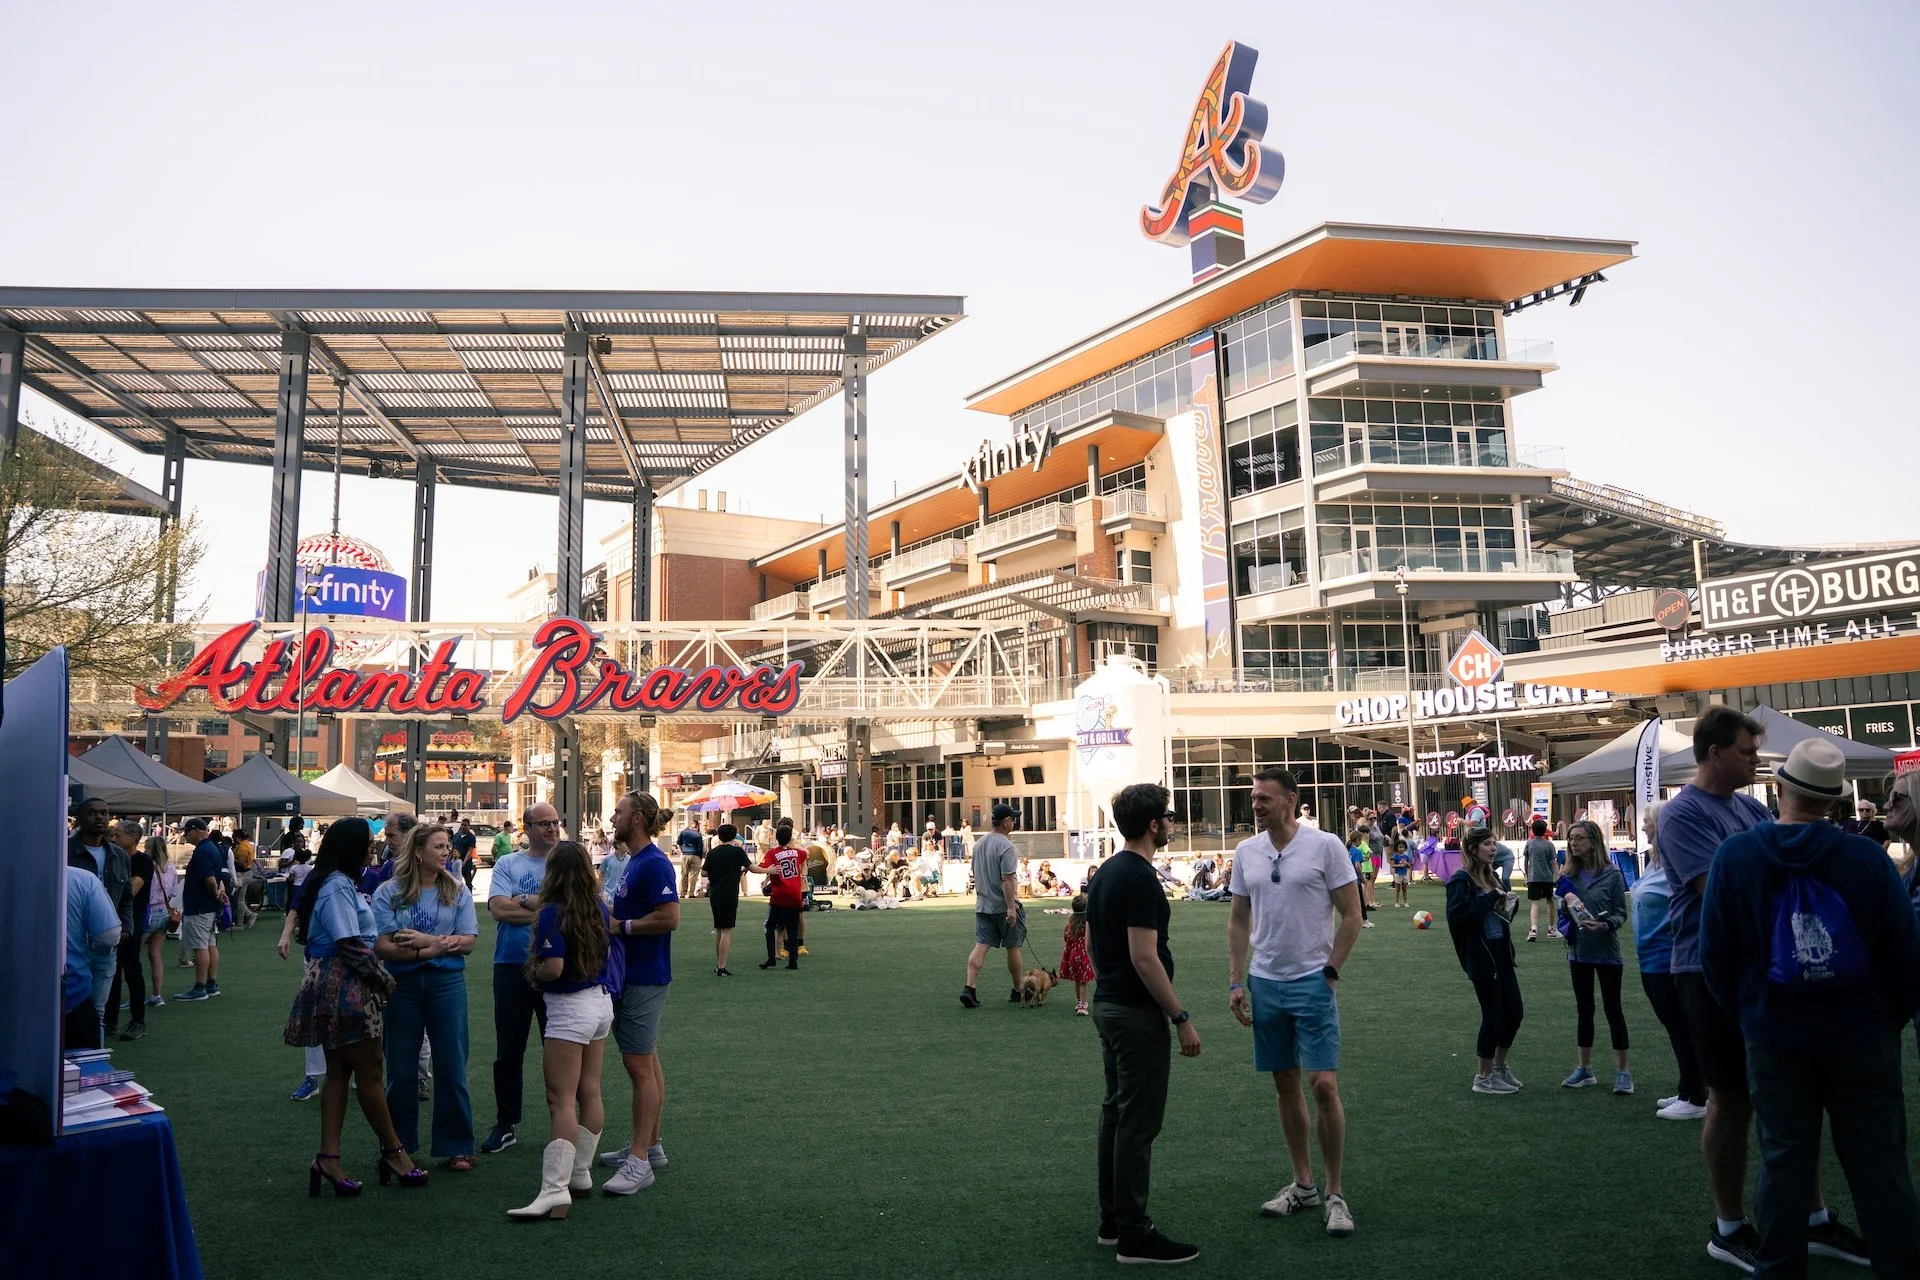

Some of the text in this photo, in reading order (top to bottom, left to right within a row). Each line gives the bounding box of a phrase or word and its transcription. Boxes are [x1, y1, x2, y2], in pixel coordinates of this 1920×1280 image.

[957, 423, 1052, 495] xfinity
[300, 573, 394, 611] xfinity
[581, 573, 598, 599] ARK
[1709, 581, 1767, 620] H&F
[1656, 598, 1685, 622] OPEN
[1659, 632, 1754, 659] BURGER
[1767, 623, 1830, 645] TIME
[1845, 615, 1897, 637] ALL
[135, 615, 806, 724] Atlanta Braves
[1457, 653, 1492, 681] CH
[1335, 694, 1408, 725] CHOP
[1415, 681, 1517, 718] HOUSE
[1865, 721, 1895, 733] FRIES
[1487, 754, 1537, 772] PARK
[1643, 746, 1654, 803] questive
[424, 793, 467, 801] BOX OFFIC
[780, 857, 799, 880] 21
